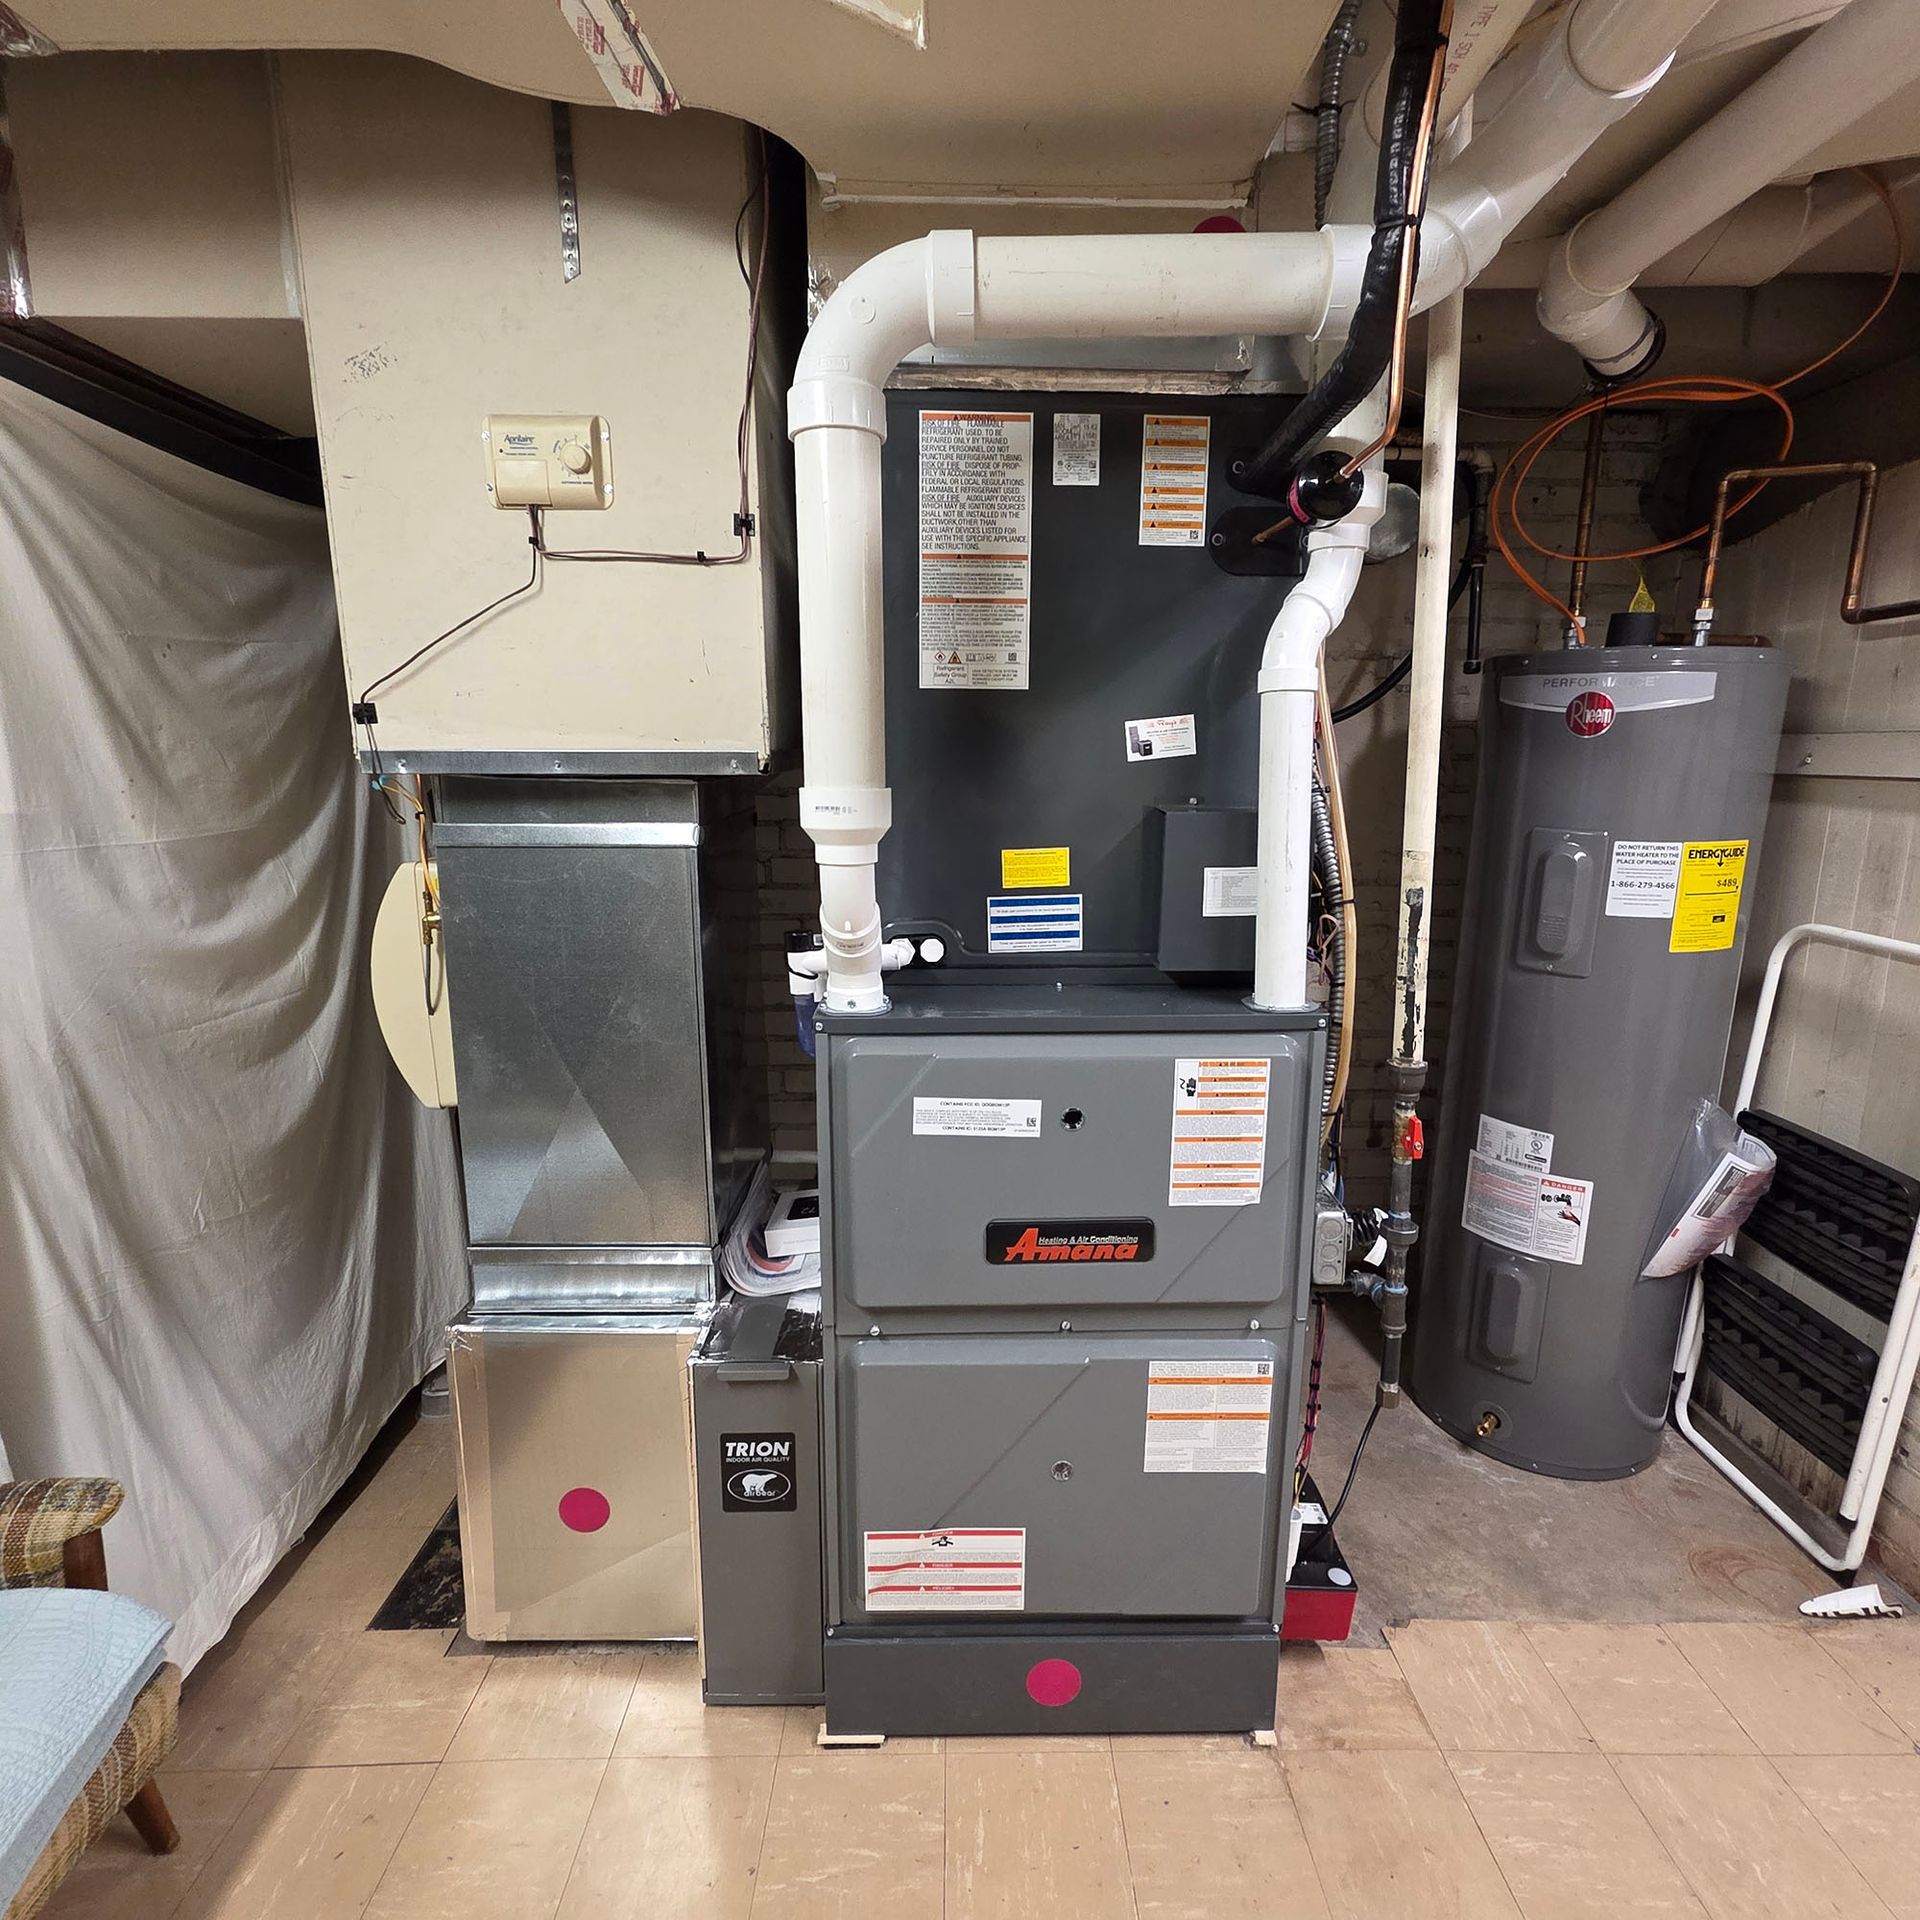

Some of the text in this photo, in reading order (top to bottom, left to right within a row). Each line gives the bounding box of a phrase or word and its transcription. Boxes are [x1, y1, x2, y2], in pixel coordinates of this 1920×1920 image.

[922, 428, 963, 436] REFRIGERANT
[987, 445, 995, 453] DO
[997, 445, 1009, 453] NOT
[922, 453, 954, 461] PUNCTURE
[960, 478, 980, 486] LOCAL
[960, 486, 1001, 494] REFRIGERANT
[922, 502, 943, 510] WHICH
[922, 510, 941, 518] SHALL
[966, 535, 992, 543] SPECIFIC
[1570, 693, 1612, 730] Rheem
[1688, 847, 1746, 860] ENERGYGUIDE
[1611, 881, 1675, 889] 1-866-279-4566
[1551, 1182, 1584, 1192] DANGER
[1038, 1235, 1139, 1246] Heating & Air Conditioning
[1004, 1228, 1139, 1262] Amana
[726, 1442, 790, 1457] TRION
